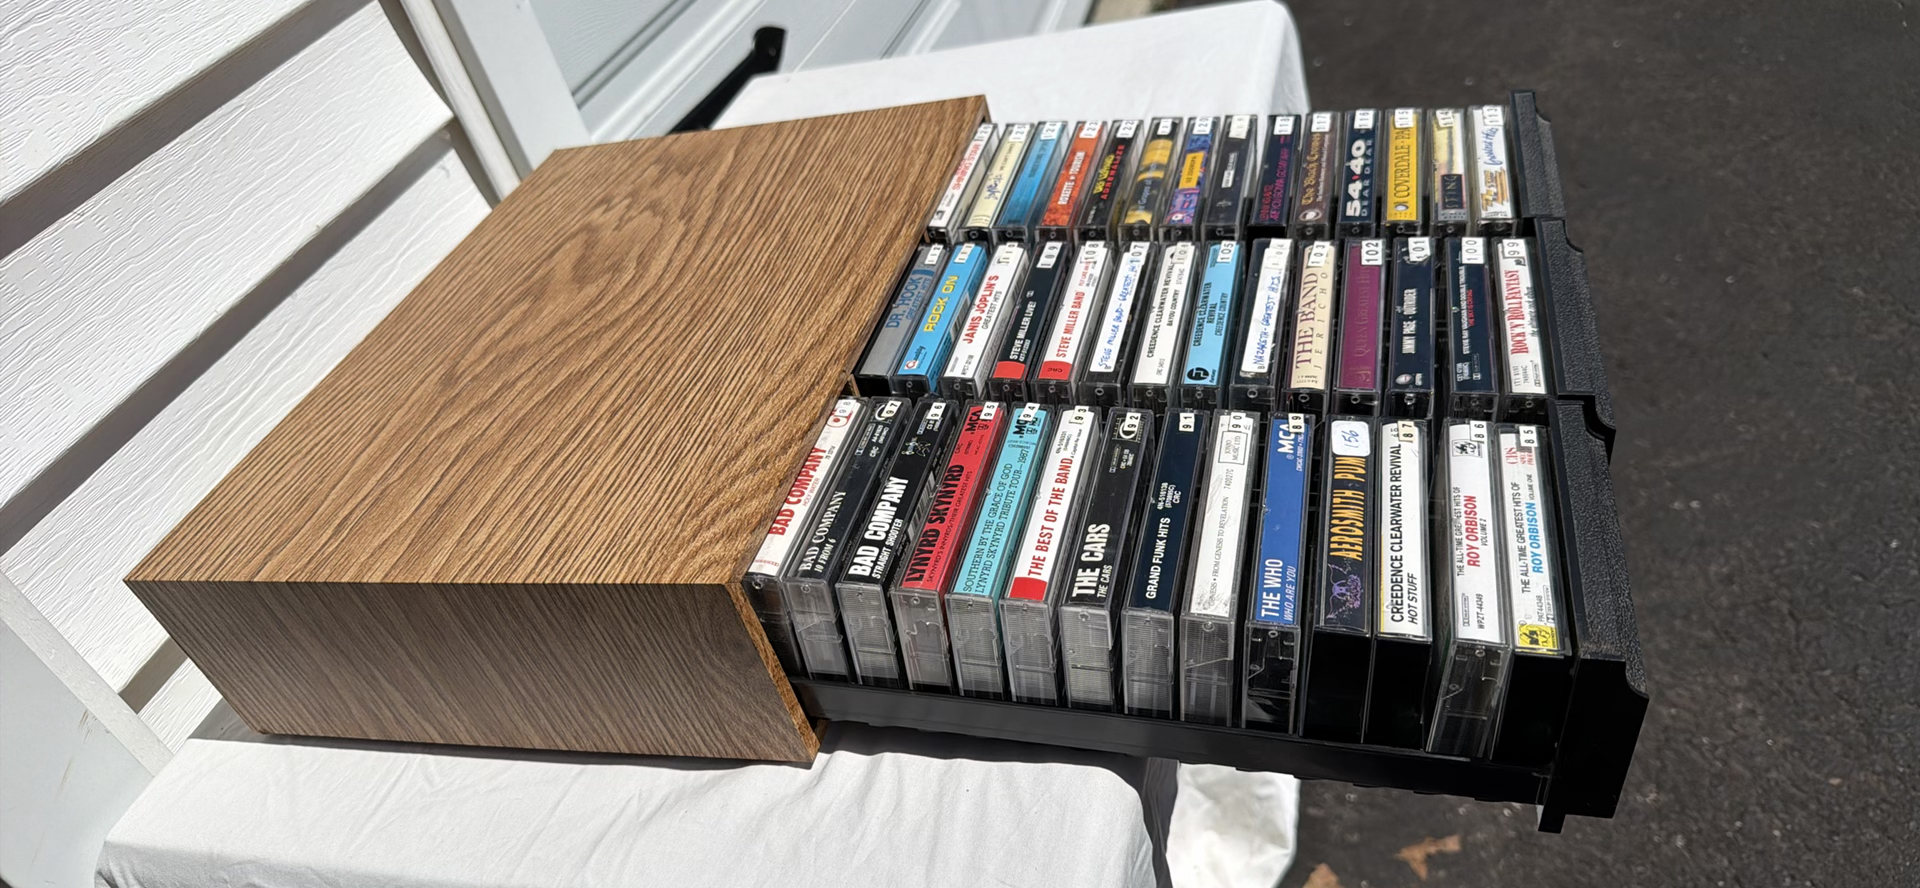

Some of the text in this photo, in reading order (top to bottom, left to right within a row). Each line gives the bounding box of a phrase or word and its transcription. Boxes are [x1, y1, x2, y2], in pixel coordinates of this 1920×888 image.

[952, 162, 972, 190] SHINING
[966, 143, 982, 160] STAR
[1057, 151, 1086, 204] ROXETTE TOURISM
[1100, 144, 1125, 199] ADRENALIZE
[1303, 162, 1318, 186] Black
[1394, 144, 1409, 198] COVERDALE
[1301, 187, 1314, 204] The
[1220, 242, 1232, 261] 105
[1365, 242, 1379, 262] 102
[1507, 241, 1519, 255] 99
[885, 277, 921, 328] DR. HOOK
[904, 277, 931, 319] GREATEST HITS
[923, 274, 958, 332] ROCK ON
[1299, 272, 1318, 324] BAND
[1502, 269, 1522, 299] FANTASY
[1524, 286, 1533, 298] album
[1526, 300, 1534, 308] rock
[961, 274, 999, 343] JANIS JOPLIN'S
[981, 290, 1002, 329] GREATEST HITS
[1009, 339, 1022, 359] STEVE
[1016, 316, 1031, 338] MILLER
[1024, 300, 1036, 316] LIVE!
[1055, 291, 1085, 357] STEVE MILLER BAND
[1146, 264, 1174, 358] CREEDENCE CLEARWATER REVIVAL
[1166, 310, 1174, 326] BAYOU
[1170, 289, 1180, 309] COUNTRY
[1192, 281, 1211, 346] CREEDENCE CLEARWATER
[1206, 302, 1217, 323] REVIVAL
[1214, 292, 1228, 336] CREEDENCE COUNTRY
[1402, 288, 1416, 353] JIMMY PAGE OUTRIDER
[1506, 300, 1524, 320] ROLL
[1098, 324, 1120, 366] STEVE MILLER
[1295, 326, 1313, 369] THE
[1350, 326, 1368, 356] QUEEN
[1508, 331, 1528, 354] ROCK
[1054, 457, 1073, 484] BAND
[1390, 443, 1401, 481] REVIVAL
[863, 476, 909, 541] COMPANY
[954, 471, 972, 506] GREATEST HITS
[1048, 486, 1064, 506] THE
[798, 490, 847, 570] BAD COMPANY
[904, 463, 965, 584] LYNYRD SKYNYRD
[962, 463, 1013, 592] SOUTHERN BY THE GRACE OF GOD
[1044, 508, 1058, 522] OF
[1212, 496, 1229, 576] FROM GENESIS TO REVELATION
[1330, 488, 1364, 560] AEROSMITH
[1391, 483, 1402, 552] CLEARWATER
[1464, 495, 1480, 566] ROY ORBISON
[1479, 523, 1487, 546] VOLUME
[1511, 481, 1530, 593] THE ALL-TIME GREATEST HITS OF
[1526, 502, 1540, 548] ORBISON
[816, 544, 834, 564] FROM
[848, 544, 880, 577] BAD
[871, 518, 903, 578] STRAIGHT SHOOTER
[977, 489, 1016, 593] LYNYRD SKYNYRD TRIBUTE
[1035, 524, 1054, 552] BEST
[1071, 521, 1111, 600] THE CARS
[1144, 517, 1171, 598] GRAND FUNK HITS
[1455, 537, 1463, 562] ALL-TIME
[1027, 554, 1045, 577] THE
[1097, 564, 1112, 598] THE CARS
[1530, 550, 1543, 573] ROY
[1261, 558, 1283, 618] THE WHO
[1283, 565, 1295, 620] WHO ARE YOU
[1390, 554, 1403, 622] CREEDENCE
[1407, 572, 1418, 623] HOT STUFF
